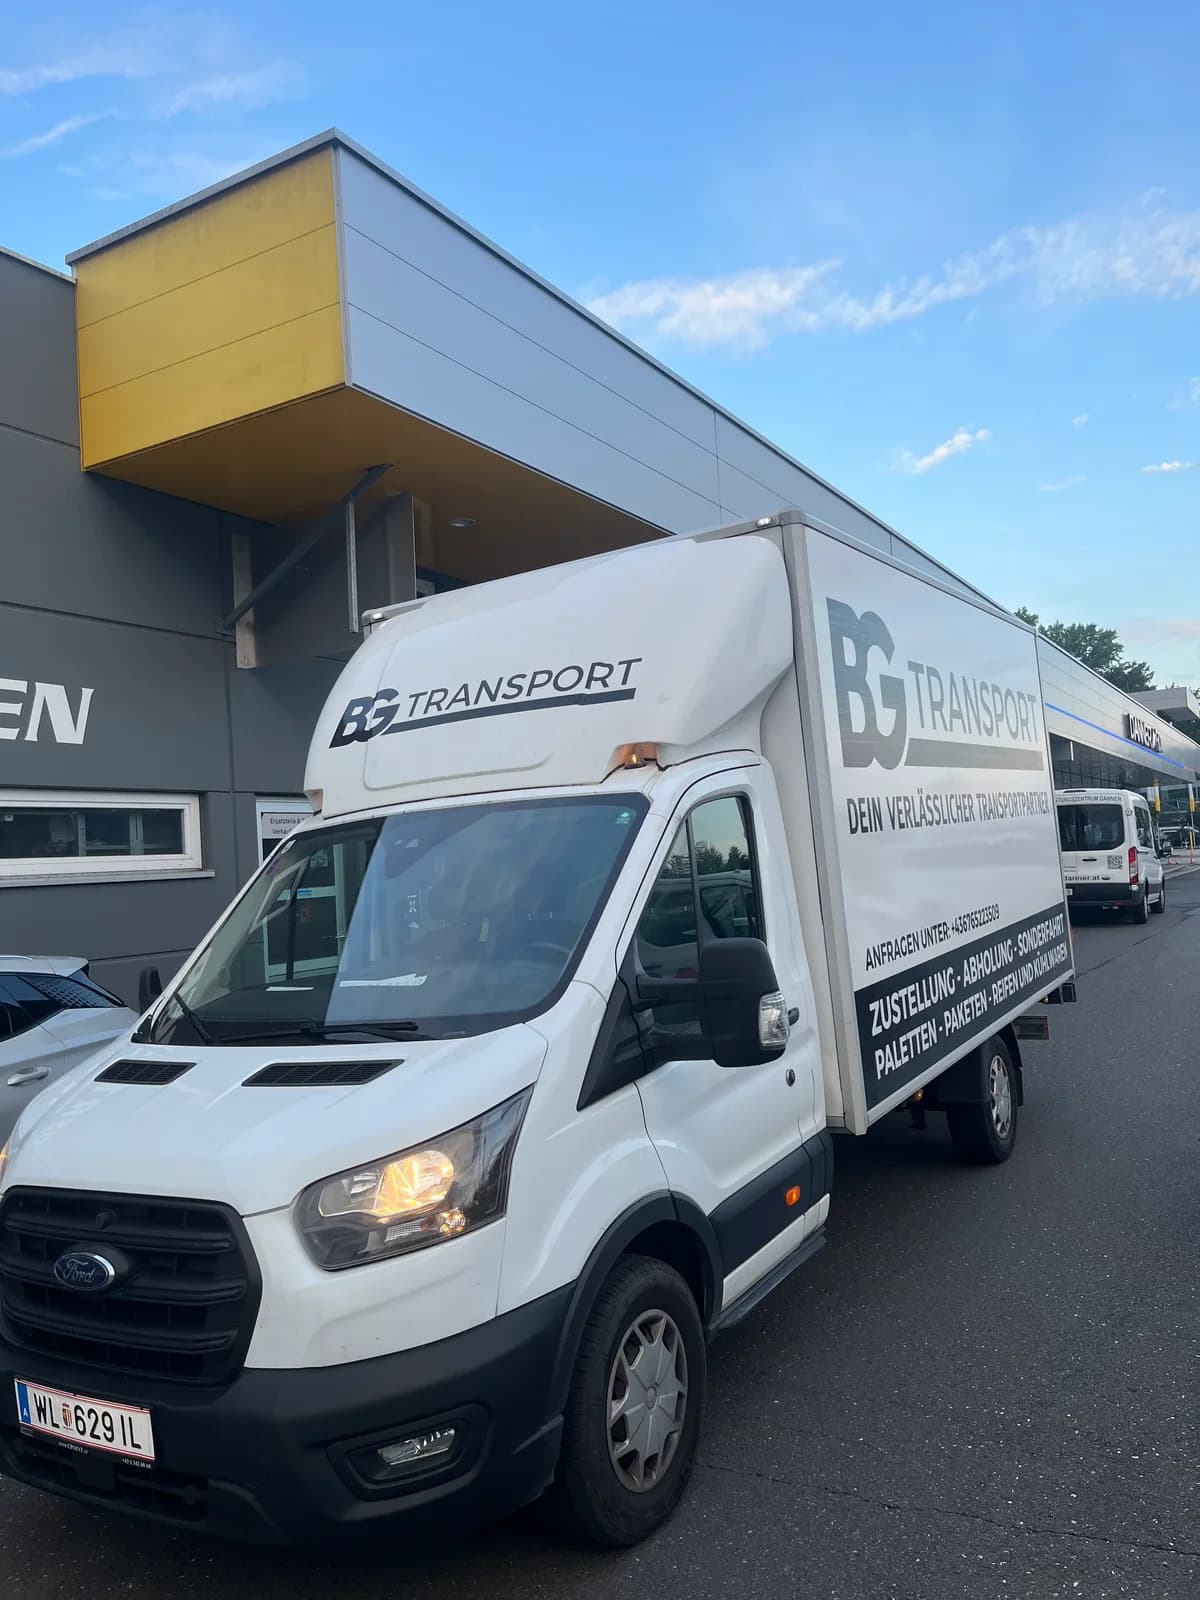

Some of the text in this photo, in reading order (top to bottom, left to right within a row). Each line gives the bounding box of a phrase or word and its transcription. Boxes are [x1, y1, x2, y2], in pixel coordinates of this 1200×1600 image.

[329, 658, 643, 749] BG TRANSPORT
[826, 597, 1039, 770] BG TRANSPORT
[847, 787, 1050, 834] DEIN VERLÄSSLICHER TRANSPORTPARTNER
[865, 903, 1000, 971] ANFRAGEN UNTER: +436765223509
[869, 967, 956, 1037] ZUSTELLUNG
[963, 939, 1014, 988] ABHOLUNG
[1018, 913, 1065, 957] SONDERFAHRT
[874, 1018, 938, 1080] PALETTEN
[943, 989, 988, 1037] PAKETEN
[991, 970, 1019, 1006] REIFEN
[1018, 962, 1034, 988] UND
[1033, 941, 1068, 979] KÜHLWAREN
[63, 1258, 97, 1284] Ford
[33, 1392, 60, 1429] WL
[73, 1404, 115, 1443] 629
[120, 1414, 142, 1450] IL
